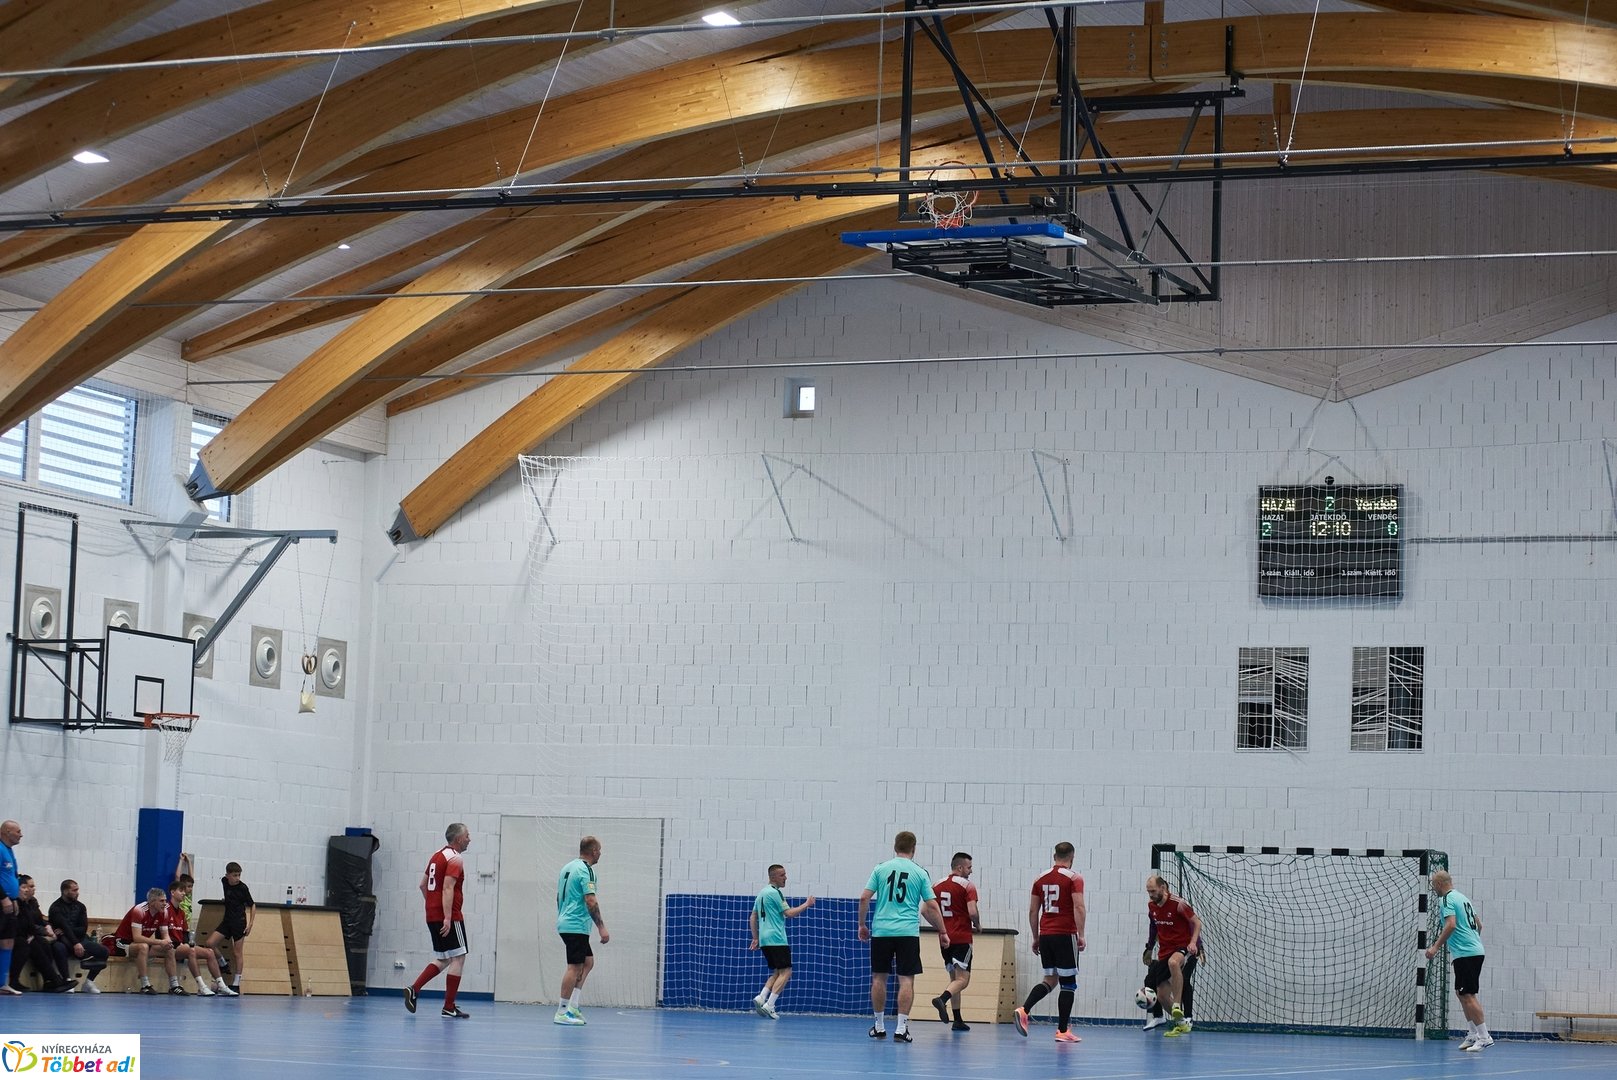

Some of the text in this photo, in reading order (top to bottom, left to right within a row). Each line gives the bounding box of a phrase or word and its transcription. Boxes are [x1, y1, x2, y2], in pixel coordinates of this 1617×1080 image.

[1261, 498, 1295, 511] HAZAI
[1325, 496, 1334, 511] 2
[1310, 511, 1347, 521] JÁTÉKIDŐ
[1367, 511, 1398, 521] VENDÉG
[1262, 522, 1272, 536] 2
[1309, 521, 1351, 536] 12:10
[1388, 521, 1398, 536] 0
[428, 862, 437, 892] 8
[886, 869, 910, 904] 15
[940, 891, 954, 918] 2
[1042, 884, 1060, 913] 12
[760, 895, 766, 922] 4
